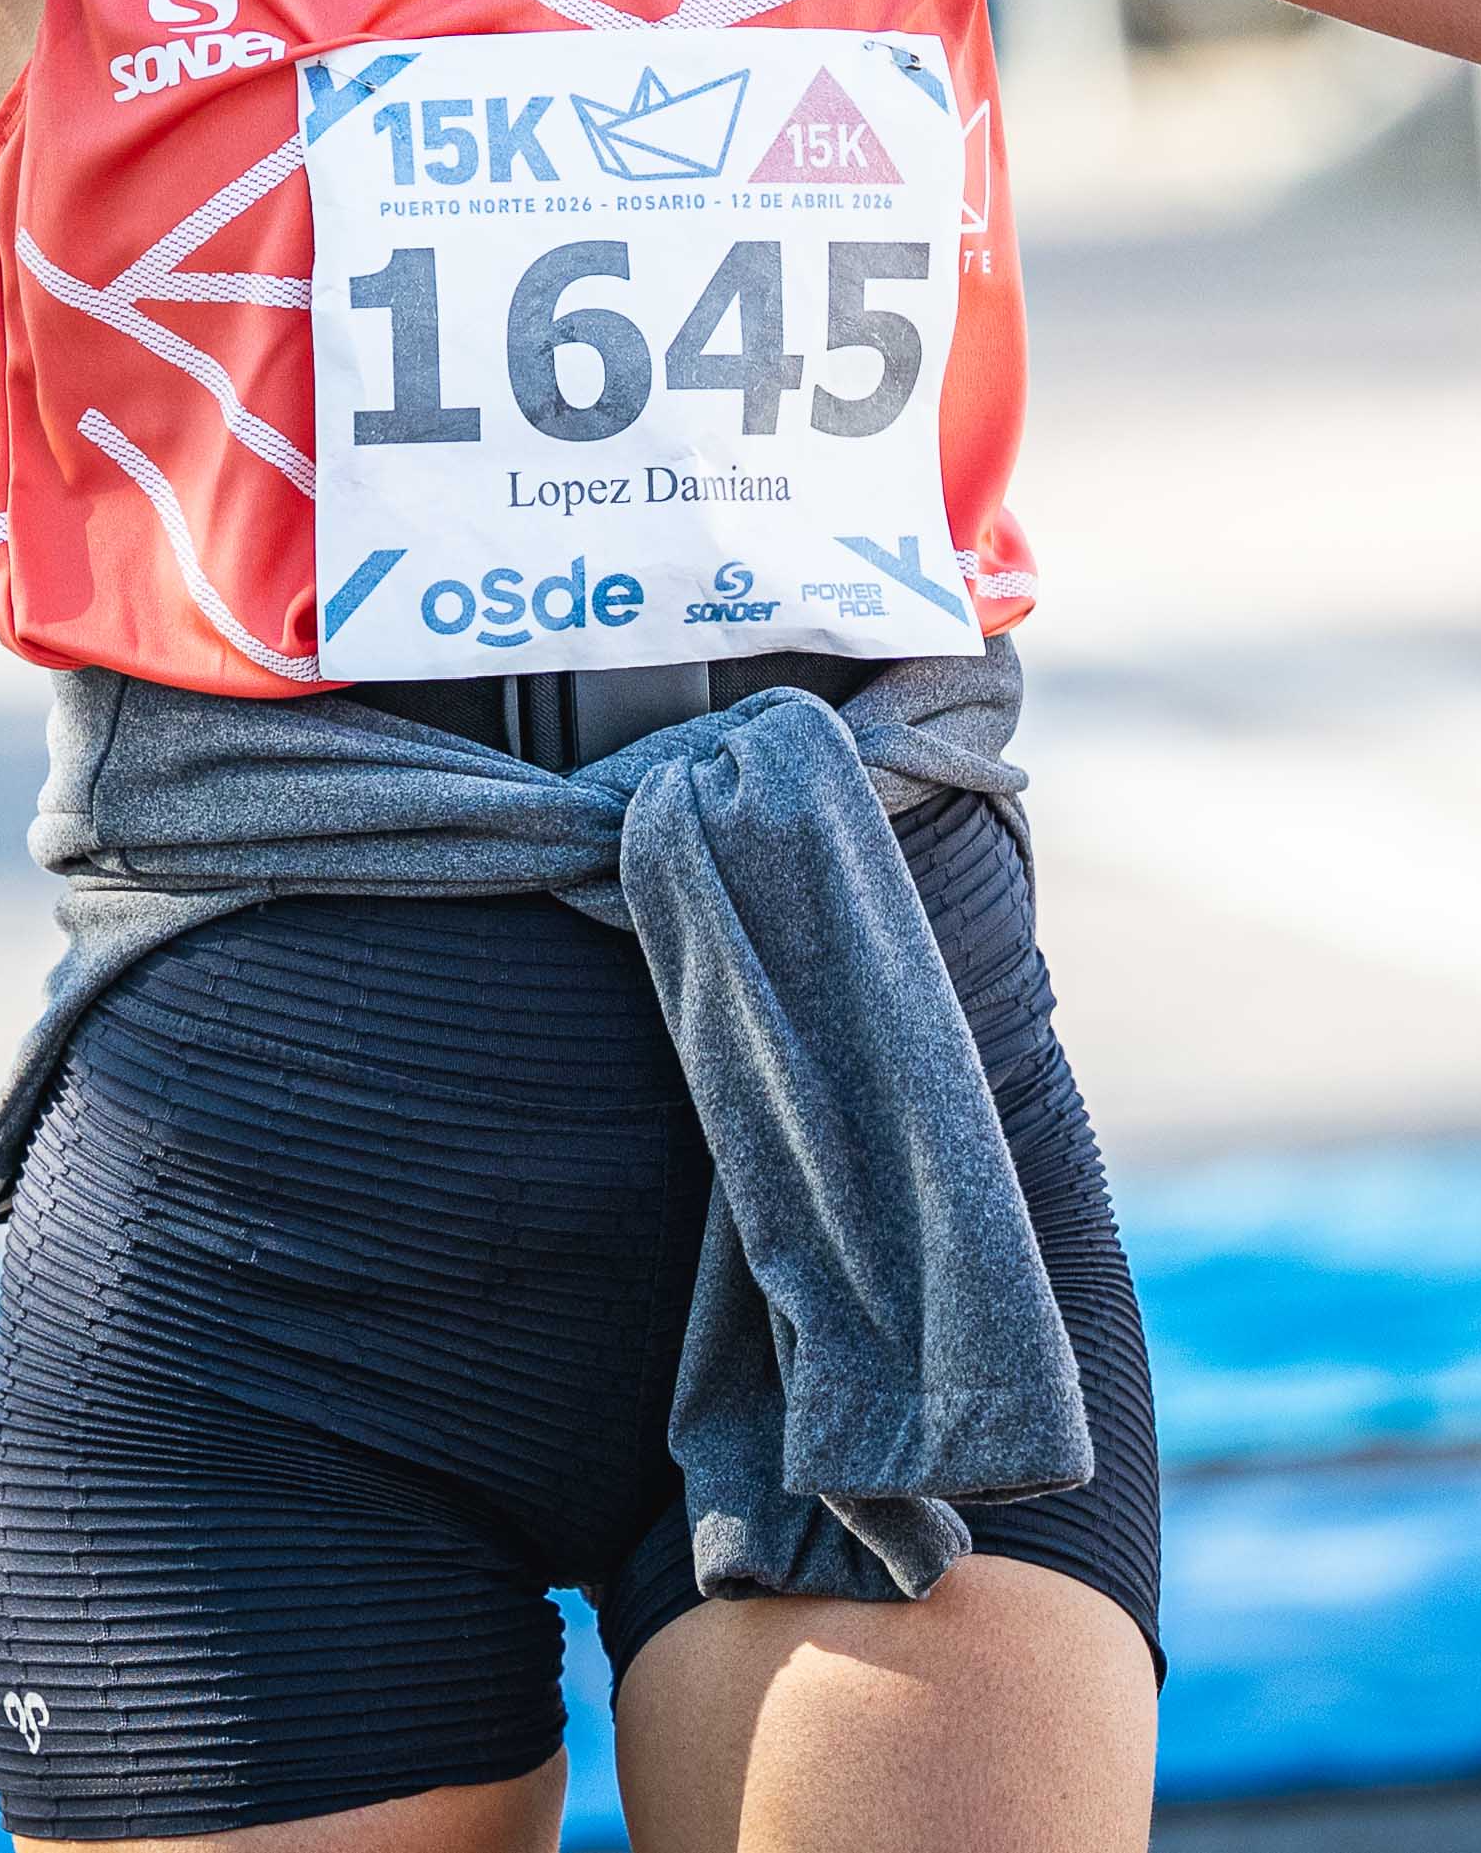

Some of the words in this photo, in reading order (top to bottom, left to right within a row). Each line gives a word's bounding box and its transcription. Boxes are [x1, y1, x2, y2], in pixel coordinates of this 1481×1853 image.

[373, 96, 561, 185] 15K
[786, 121, 870, 169] 15K
[380, 200, 460, 216] PUERTO
[469, 198, 536, 214] NORTE
[545, 197, 592, 212] 2026
[617, 194, 705, 211] ROSARIO
[731, 193, 751, 209] 12
[760, 193, 783, 209] DE
[791, 193, 844, 209] ABRIL
[852, 193, 893, 209] 2026
[349, 240, 930, 445] 1645
[507, 471, 631, 516] Lopez
[644, 465, 792, 503] Damiana
[421, 555, 644, 647] osde
[802, 583, 882, 601] POWER
